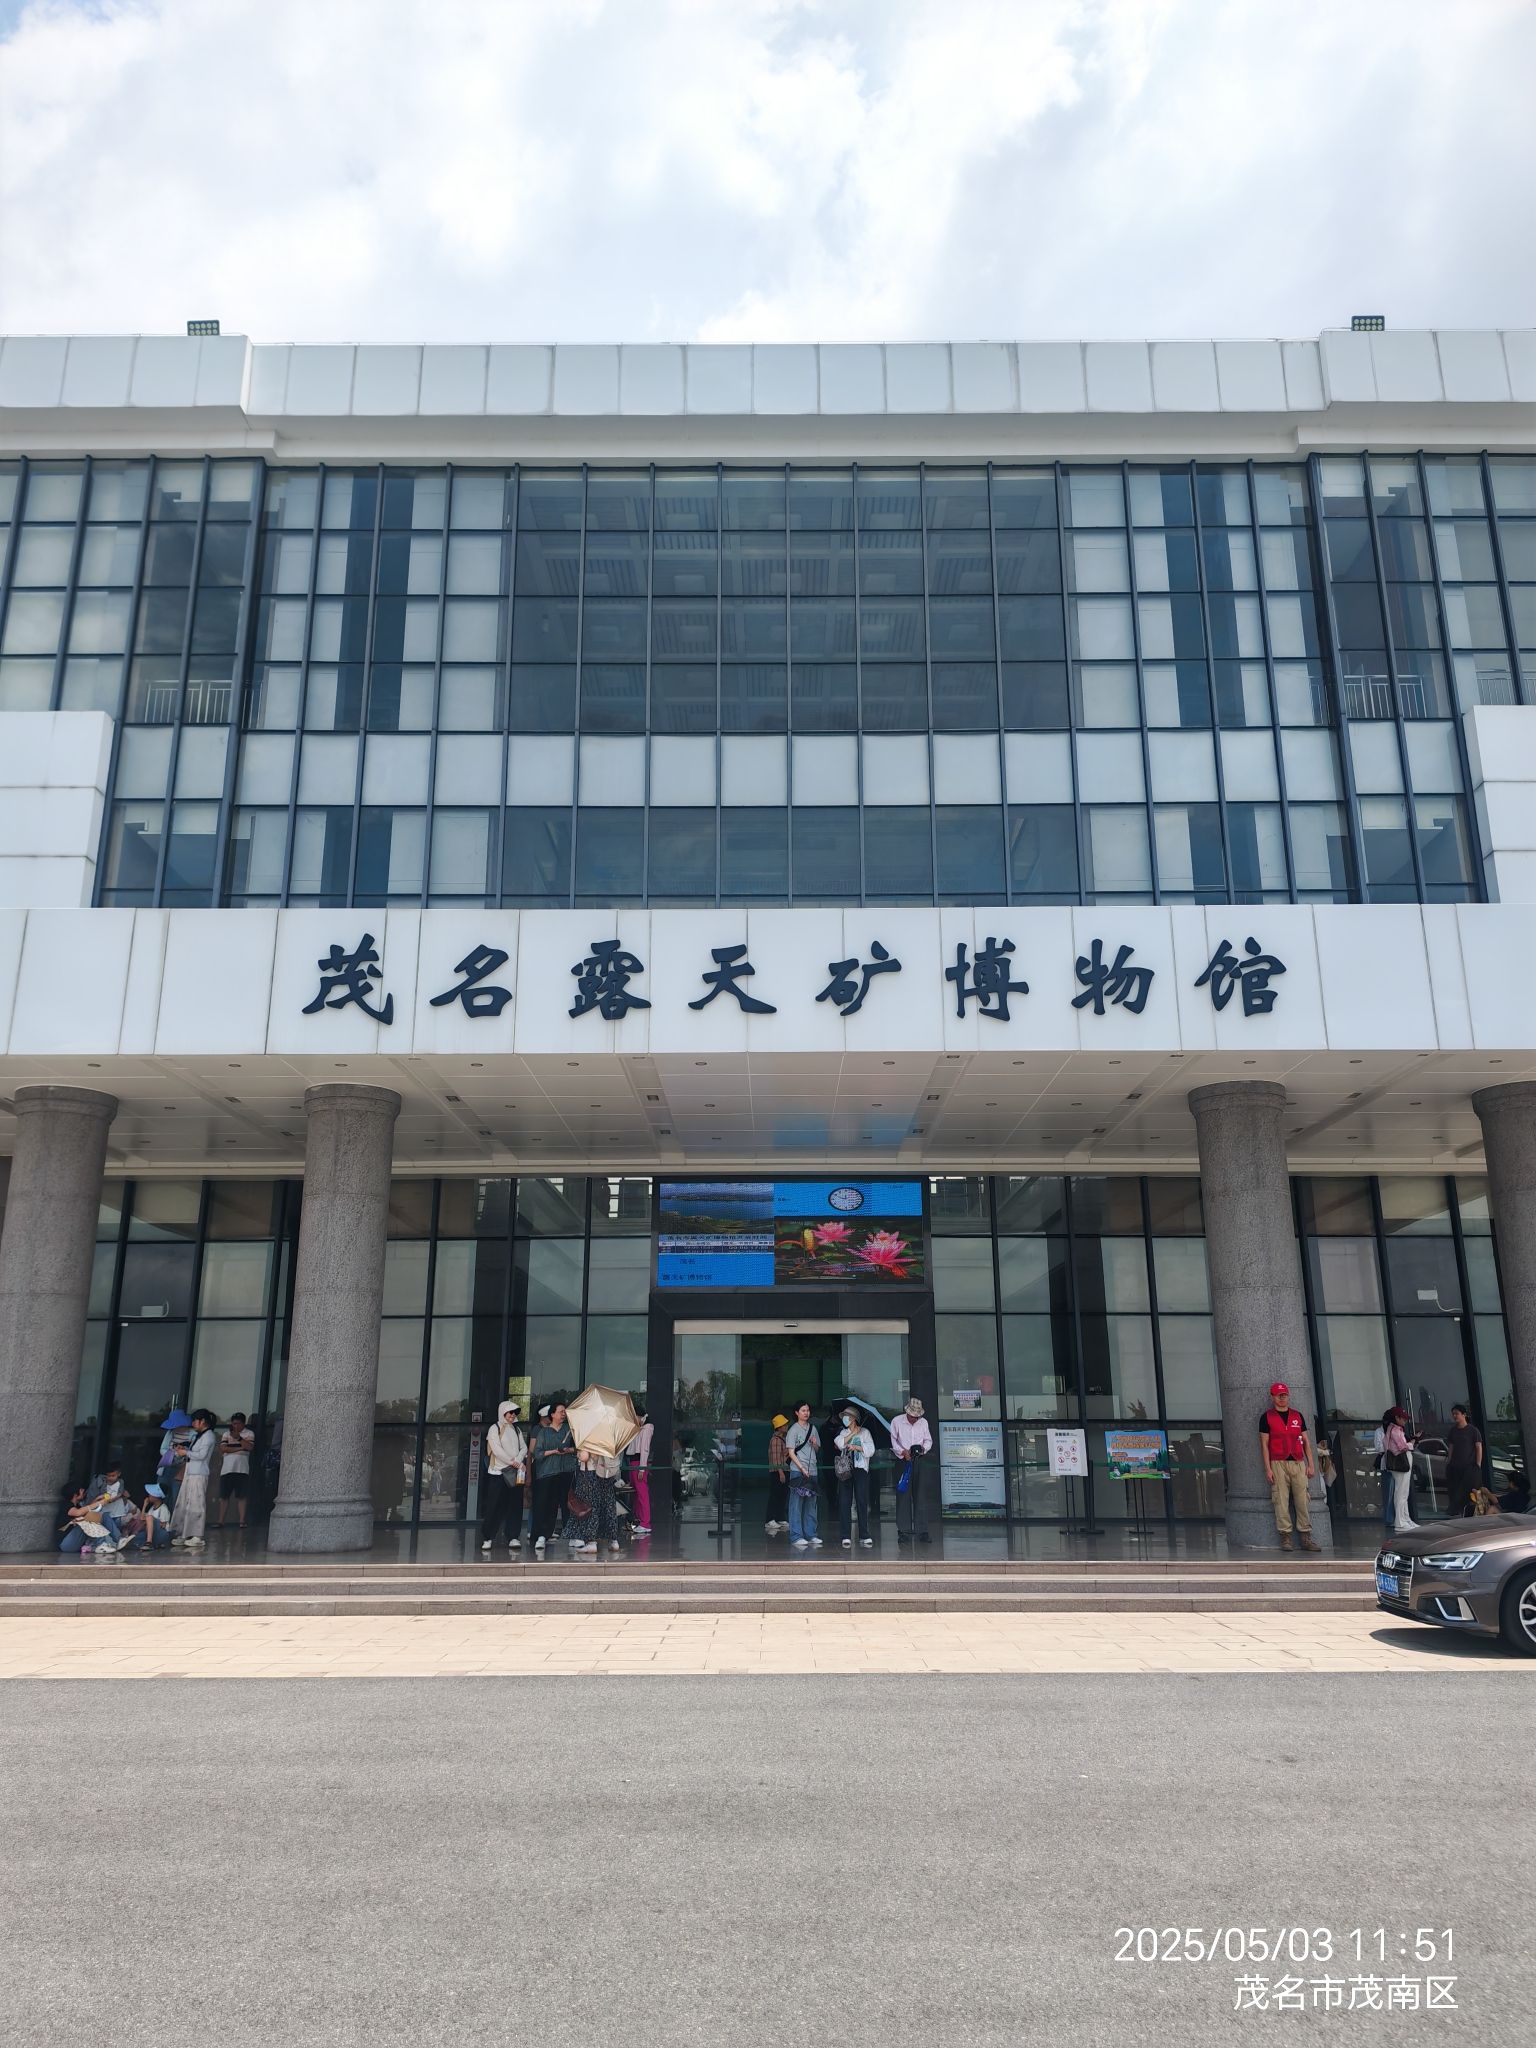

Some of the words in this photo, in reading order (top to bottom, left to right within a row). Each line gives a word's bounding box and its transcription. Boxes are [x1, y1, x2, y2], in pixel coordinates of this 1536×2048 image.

[302, 934, 1287, 1022] 茂名露天矿博物馆
